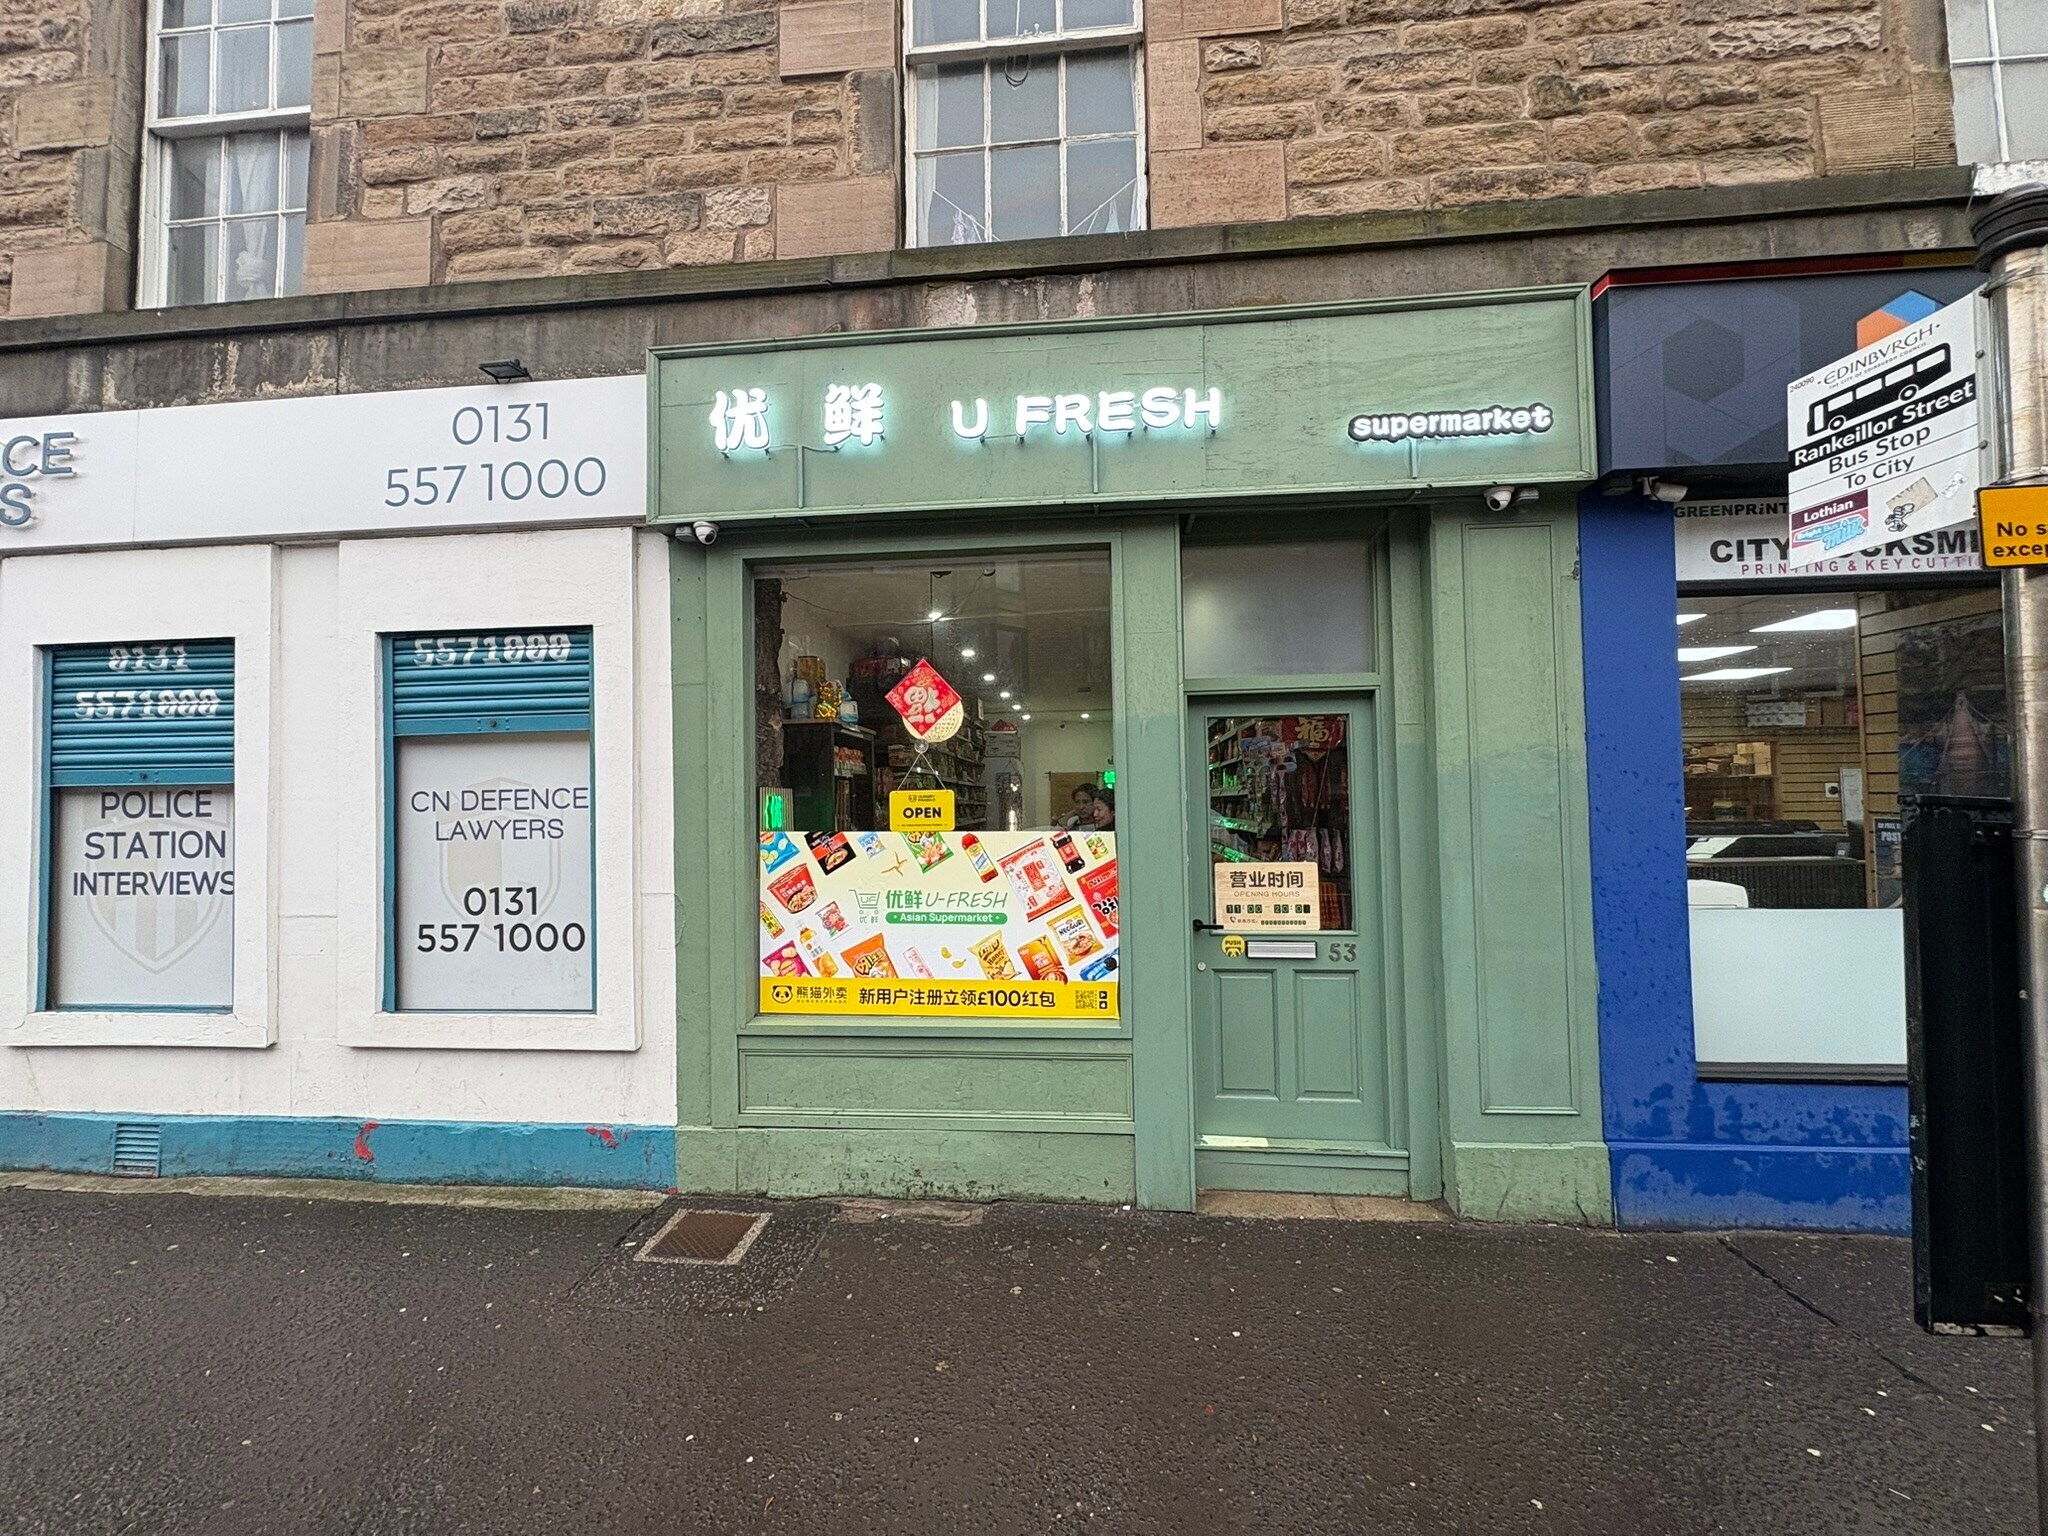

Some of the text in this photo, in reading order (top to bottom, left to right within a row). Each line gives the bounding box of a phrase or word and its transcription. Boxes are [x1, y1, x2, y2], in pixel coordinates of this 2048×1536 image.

[1824, 323, 1933, 385] EDINBVRGH
[1789, 376, 1815, 393] 240090
[452, 402, 549, 446] 0131
[952, 387, 1221, 439] U FRESH
[1351, 404, 1552, 439] supermarket
[1794, 381, 1974, 467] Rankeillor Street
[2, 432, 74, 477] CE
[1828, 426, 1931, 475] Bus Stop
[384, 456, 606, 507] 557 1000
[1843, 455, 1916, 489] To City
[0, 483, 32, 526] S
[1803, 500, 1854, 523] Lothian
[1996, 521, 2028, 537] No
[1709, 538, 1789, 563] CITY
[1847, 560, 1857, 571] &
[1865, 558, 1903, 571] KEY
[108, 645, 192, 672] 0131
[413, 633, 572, 667] 5571000
[75, 689, 221, 720] 5571000
[101, 790, 213, 819] POLICE
[411, 787, 589, 812] CN DEFENCE
[902, 807, 942, 819] OPEN
[436, 818, 564, 841] LAWYERS
[84, 830, 226, 860] STATION
[73, 871, 234, 896] INTERVIEWS
[1229, 870, 1304, 889] 营业时间
[464, 886, 537, 916] 0131
[860, 896, 877, 904] UF
[885, 889, 923, 909] 优鲜
[925, 890, 1008, 909] U-FRESH
[1233, 890, 1300, 898] OPENING HOURS
[899, 912, 993, 926] Asian Supermarket
[1226, 904, 1263, 914] 11:00
[1273, 904, 1311, 914] 20:0
[417, 922, 586, 953] 557 1000
[1328, 943, 1357, 962] 53
[796, 986, 1056, 1008] 熊猫外卖 新用户注册立领£100红包
